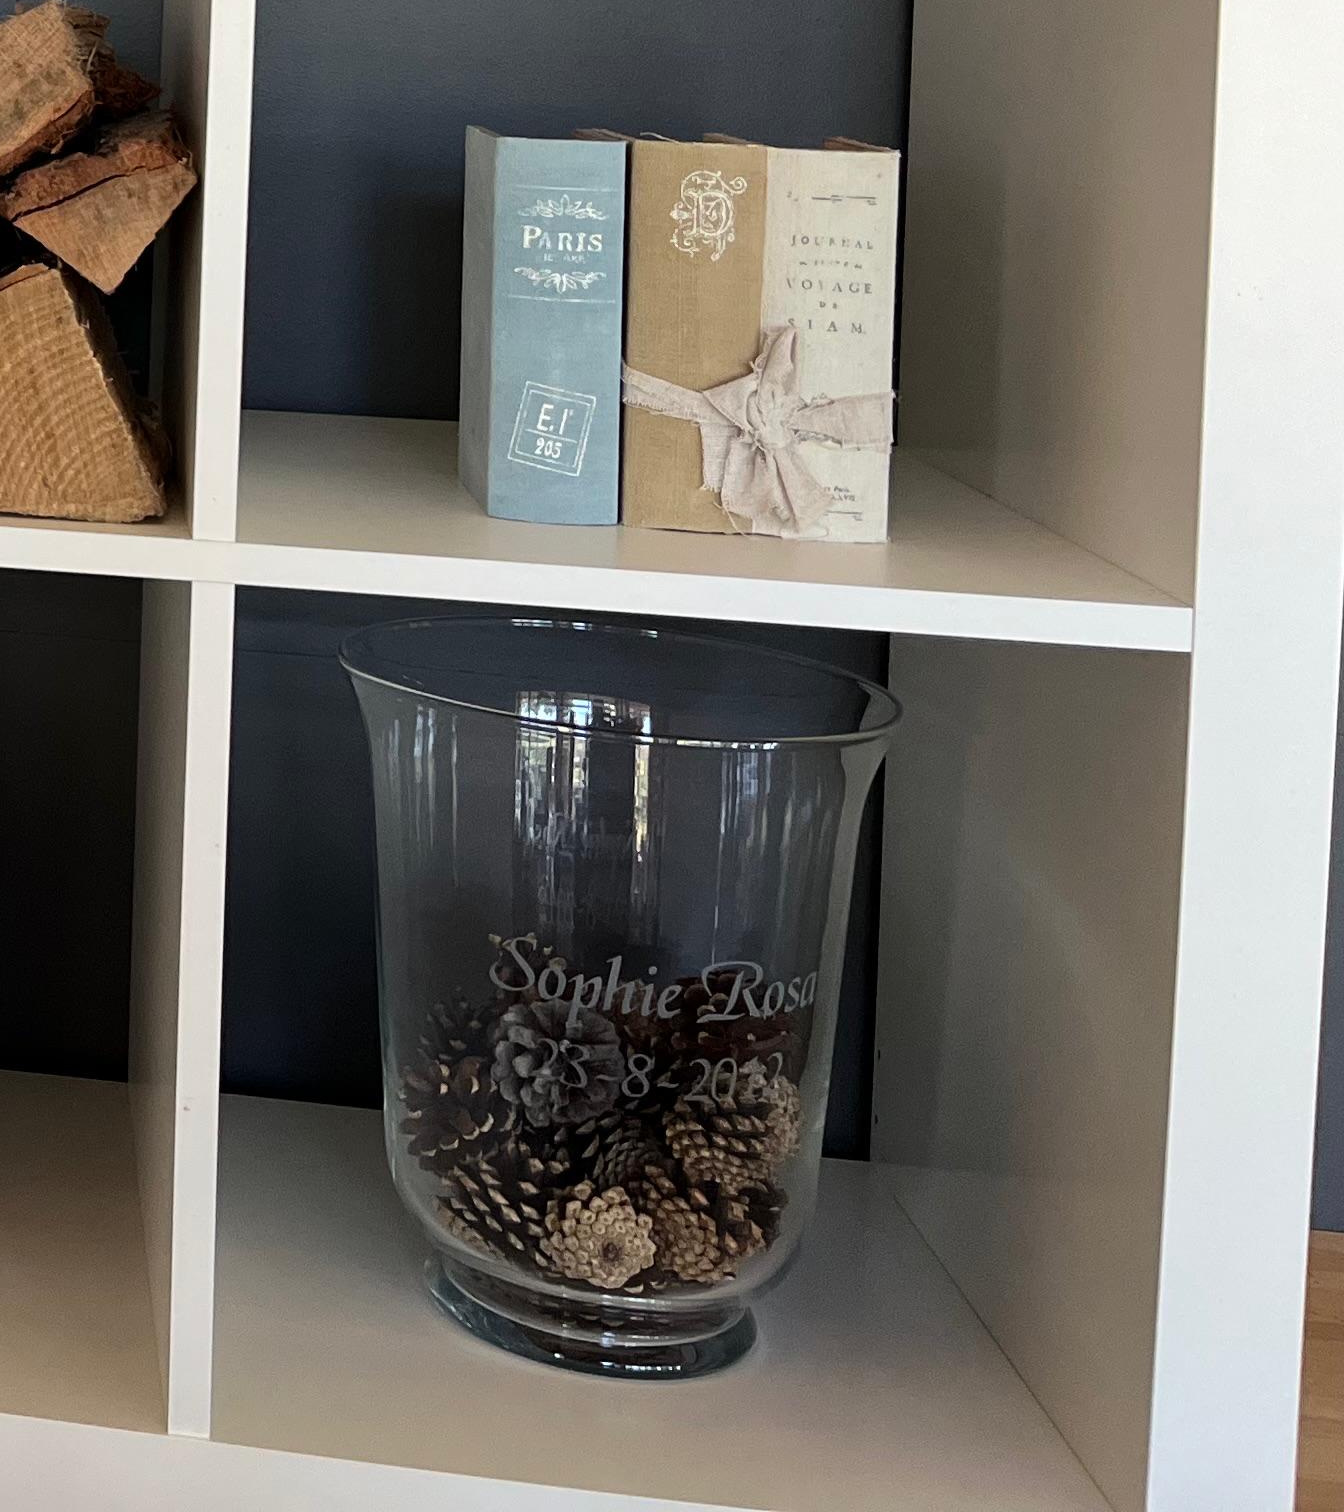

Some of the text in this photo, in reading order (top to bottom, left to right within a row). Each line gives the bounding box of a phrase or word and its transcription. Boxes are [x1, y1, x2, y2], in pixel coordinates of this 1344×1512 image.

[521, 224, 603, 253] PARIS
[534, 437, 563, 460] 205
[489, 936, 818, 1032] Sophie Rosa
